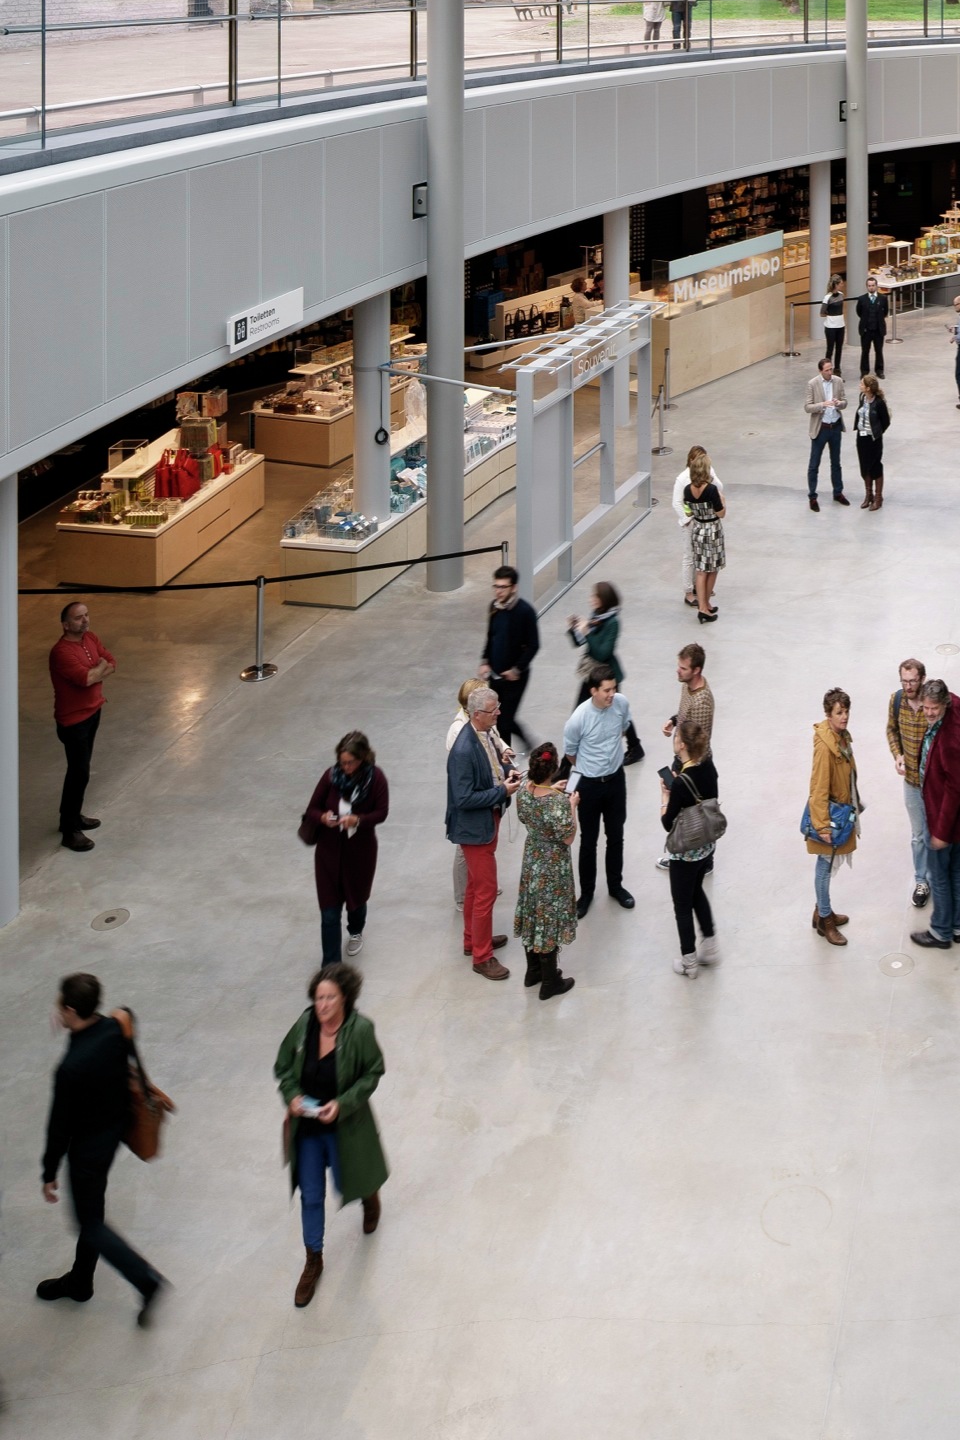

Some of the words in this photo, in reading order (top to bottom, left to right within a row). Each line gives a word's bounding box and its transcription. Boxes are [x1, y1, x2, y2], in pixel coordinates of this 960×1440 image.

[673, 256, 780, 304] Museumshop
[250, 308, 275, 324] Toiletten
[250, 318, 279, 336] Restrooms
[578, 342, 616, 376] Souvenir
